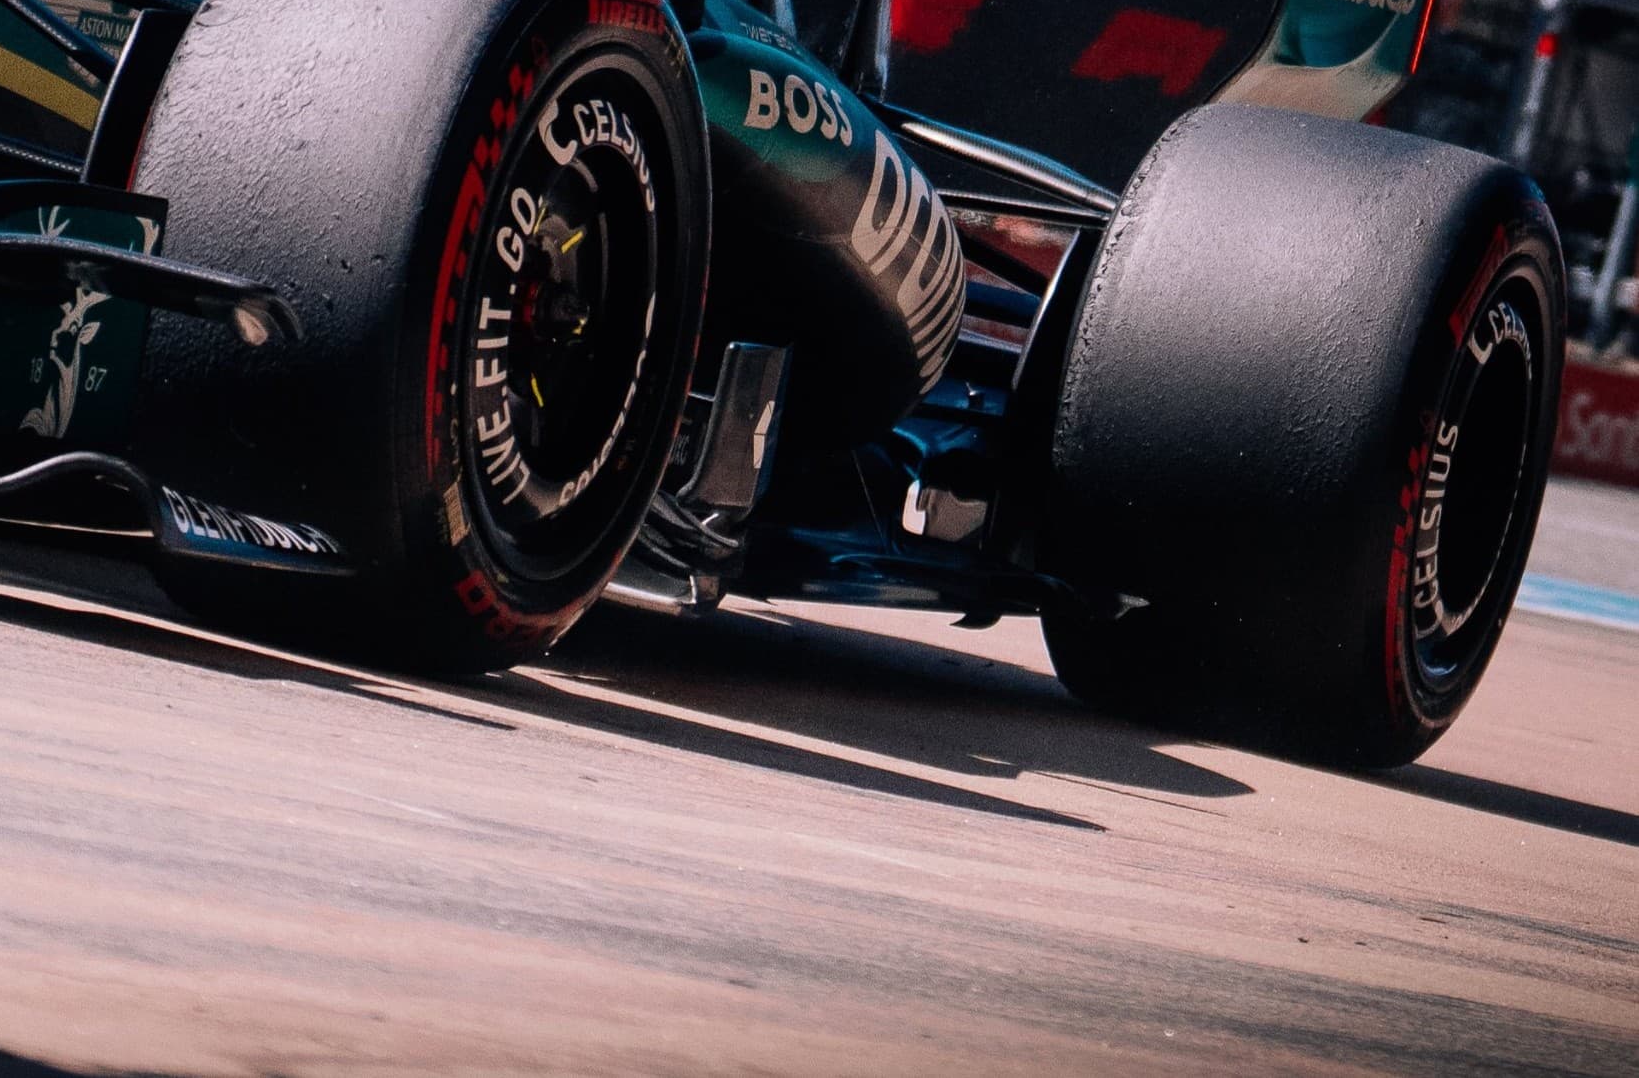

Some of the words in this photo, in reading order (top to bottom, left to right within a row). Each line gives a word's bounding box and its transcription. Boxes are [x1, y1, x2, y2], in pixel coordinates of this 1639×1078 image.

[572, 98, 656, 213] CELSIUS
[743, 68, 853, 147] BOSS
[84, 366, 108, 393] 87
[1412, 420, 1460, 610] CELSIUS
